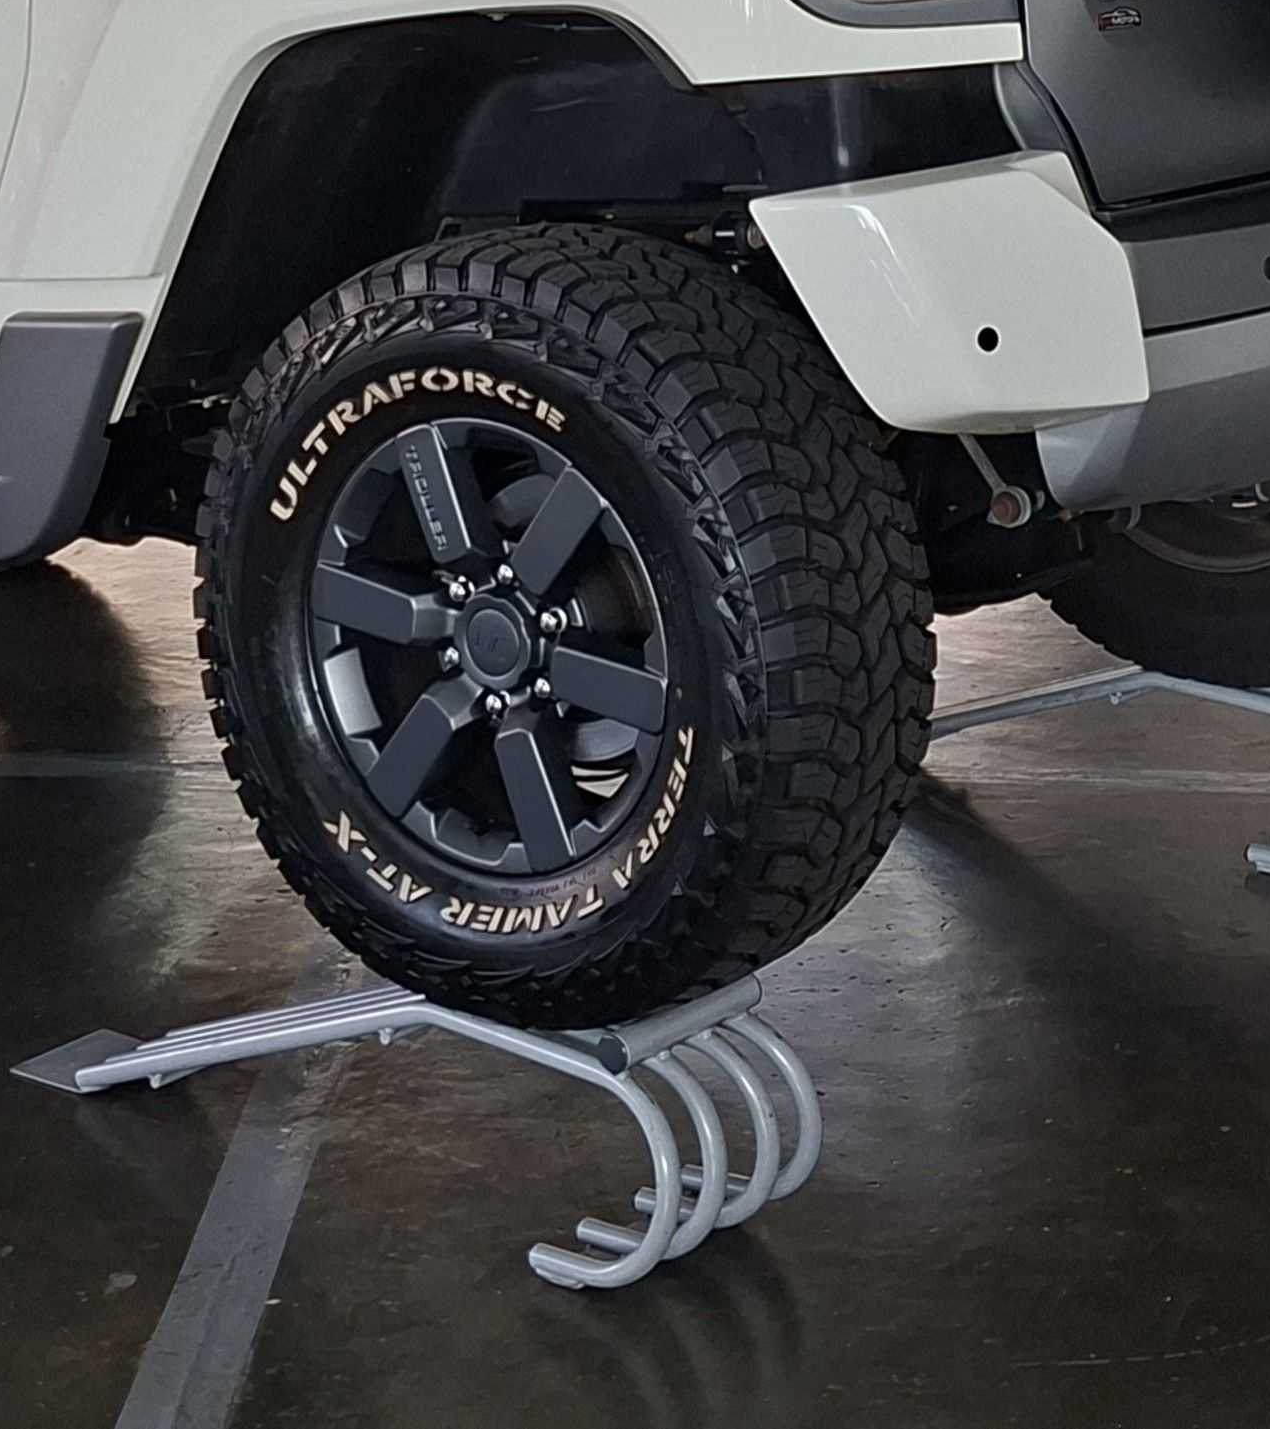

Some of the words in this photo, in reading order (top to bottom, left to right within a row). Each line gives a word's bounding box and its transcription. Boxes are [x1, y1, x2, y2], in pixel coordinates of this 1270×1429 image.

[269, 367, 567, 523] ULTRAFORCE
[324, 809, 434, 904] AT-X
[610, 726, 696, 888] TERRA
[439, 882, 605, 934] TAMER
